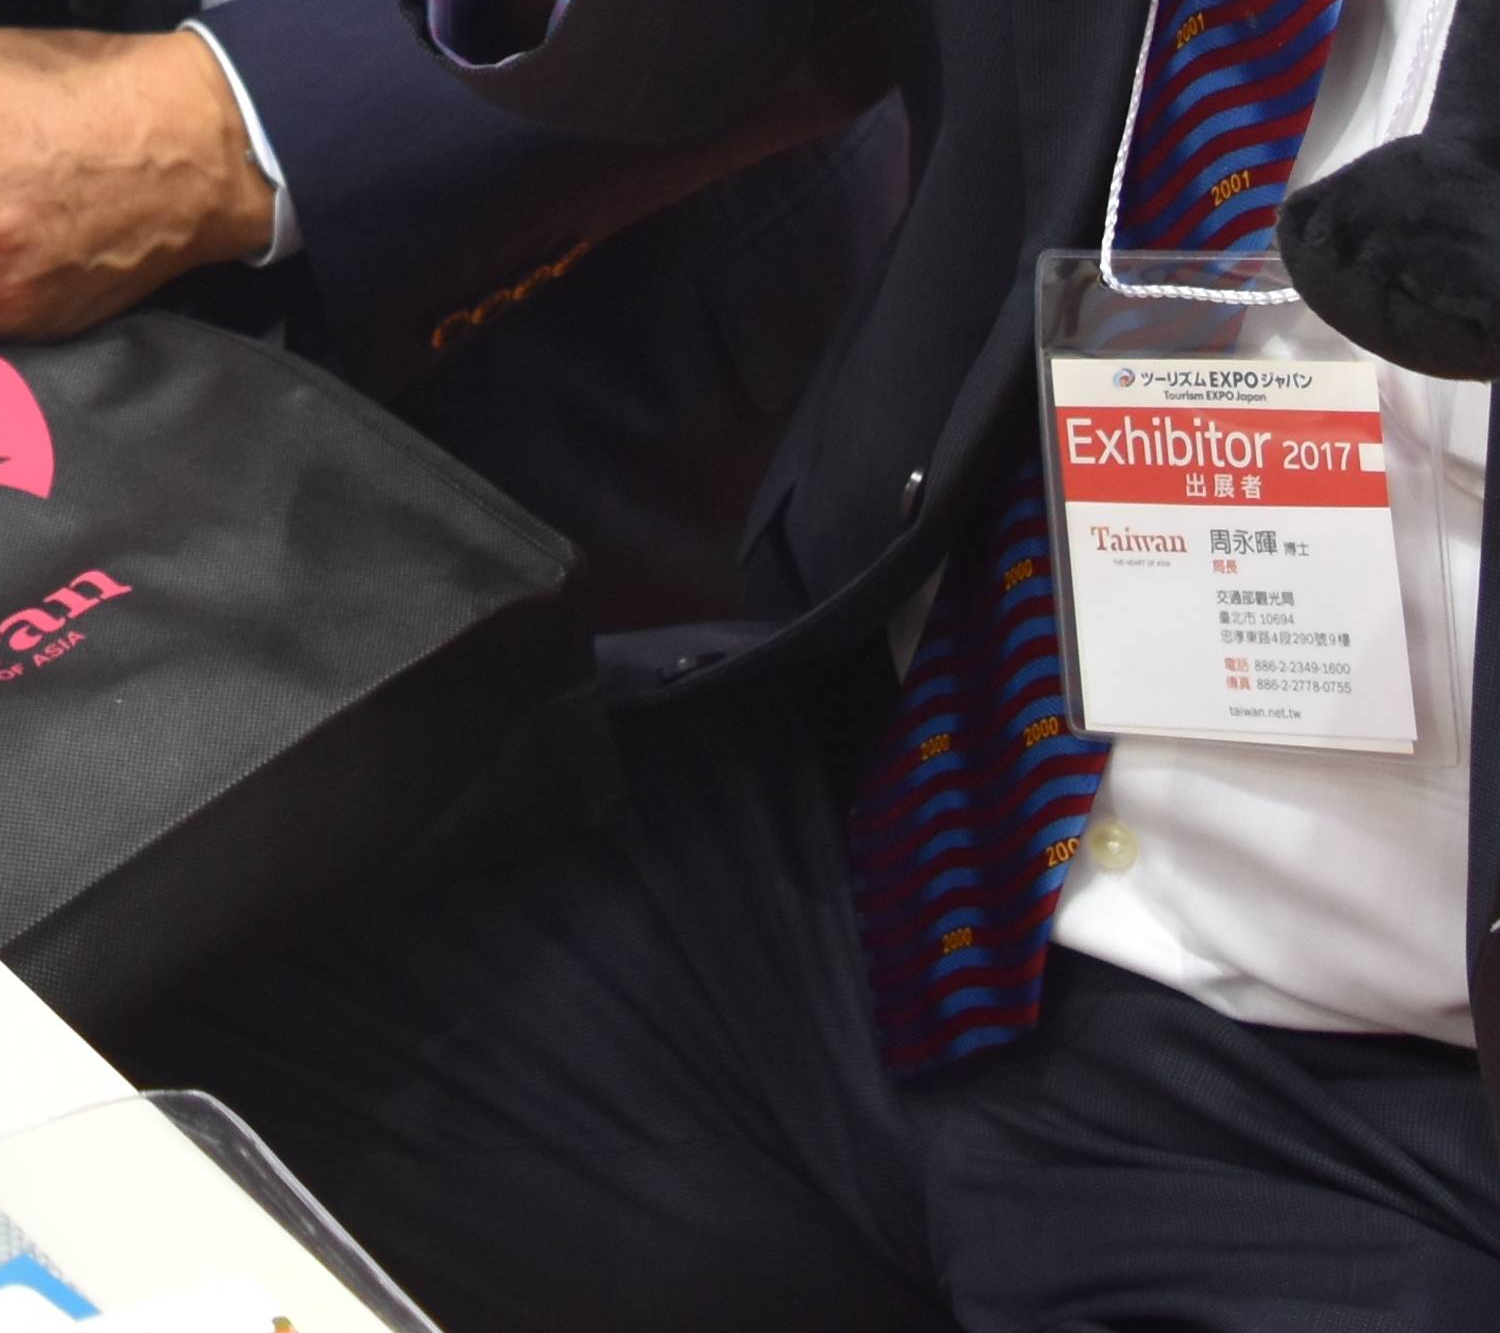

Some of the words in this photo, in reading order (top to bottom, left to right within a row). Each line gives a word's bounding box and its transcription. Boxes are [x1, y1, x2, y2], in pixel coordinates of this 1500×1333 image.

[1210, 170, 1252, 207] 2001
[1164, 390, 1204, 401] Tourism
[1206, 391, 1234, 401] EXPO
[1236, 391, 1267, 403] Japan
[1066, 416, 1272, 469] Exhibitor
[1282, 441, 1351, 471] 2017
[1091, 526, 1188, 553] Taiwan
[32, 631, 87, 668] ASIA
[1023, 716, 1059, 747] 2000
[1045, 837, 1081, 867] 200
